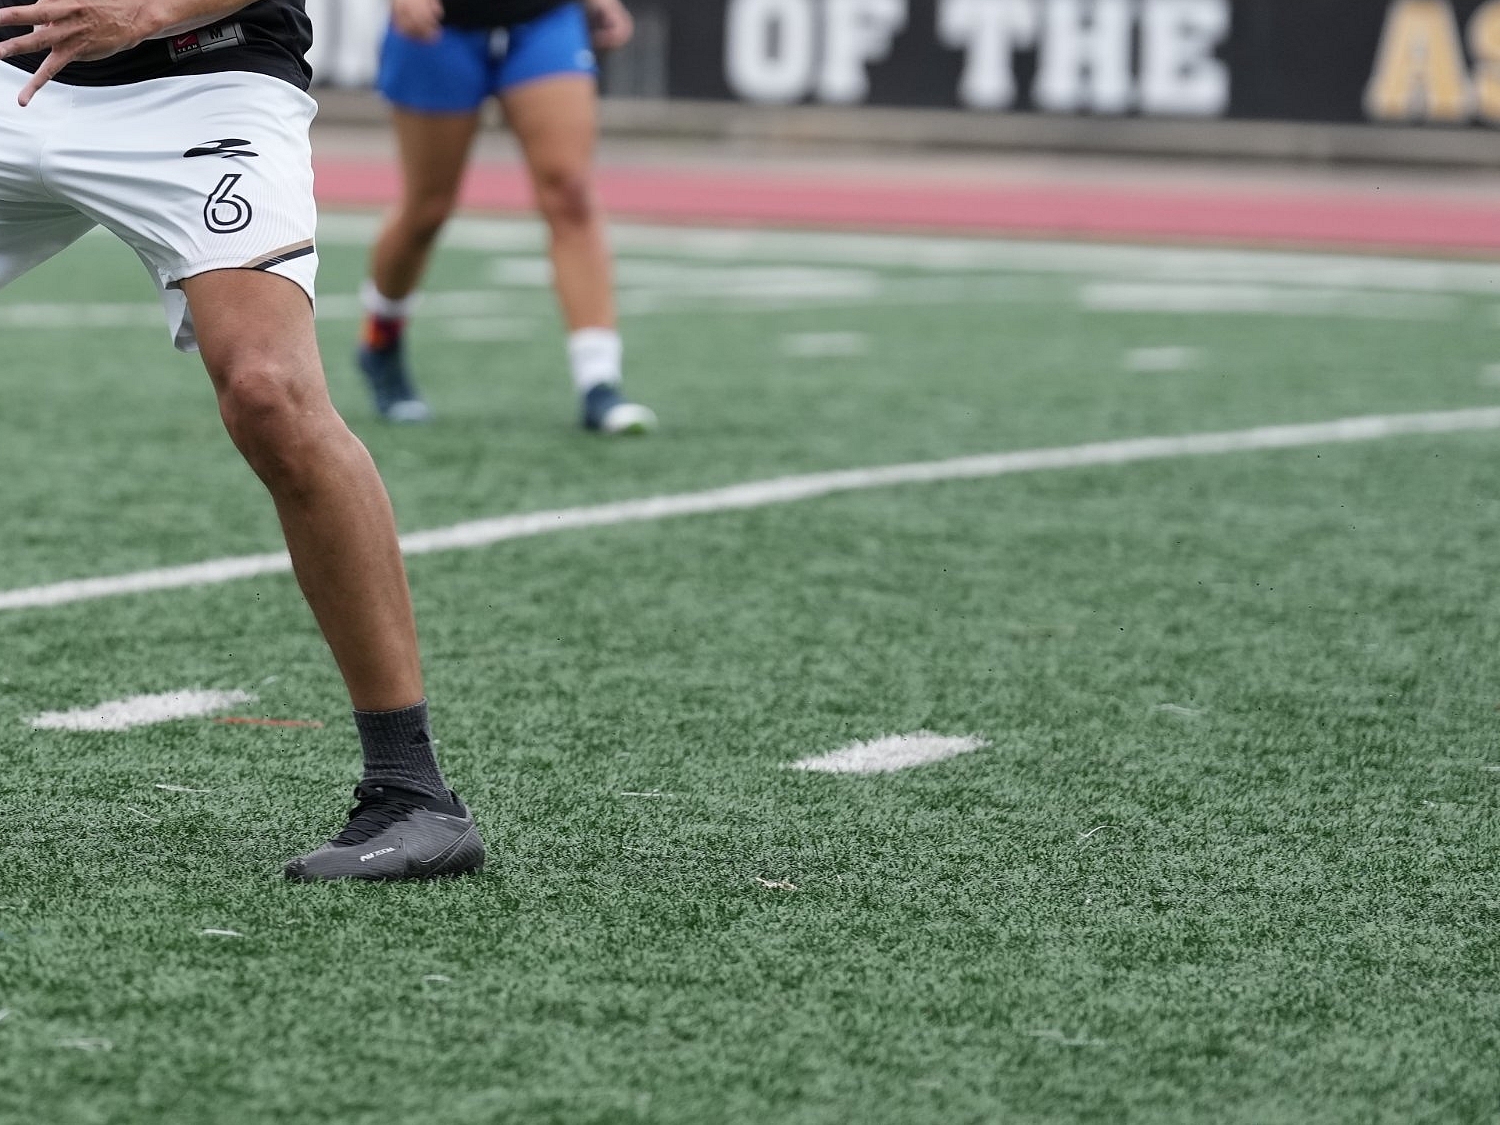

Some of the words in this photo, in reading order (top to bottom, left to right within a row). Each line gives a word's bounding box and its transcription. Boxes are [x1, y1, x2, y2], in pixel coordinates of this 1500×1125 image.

[210, 27, 224, 40] M
[178, 44, 198, 53] TEAM
[203, 173, 252, 234] 6
